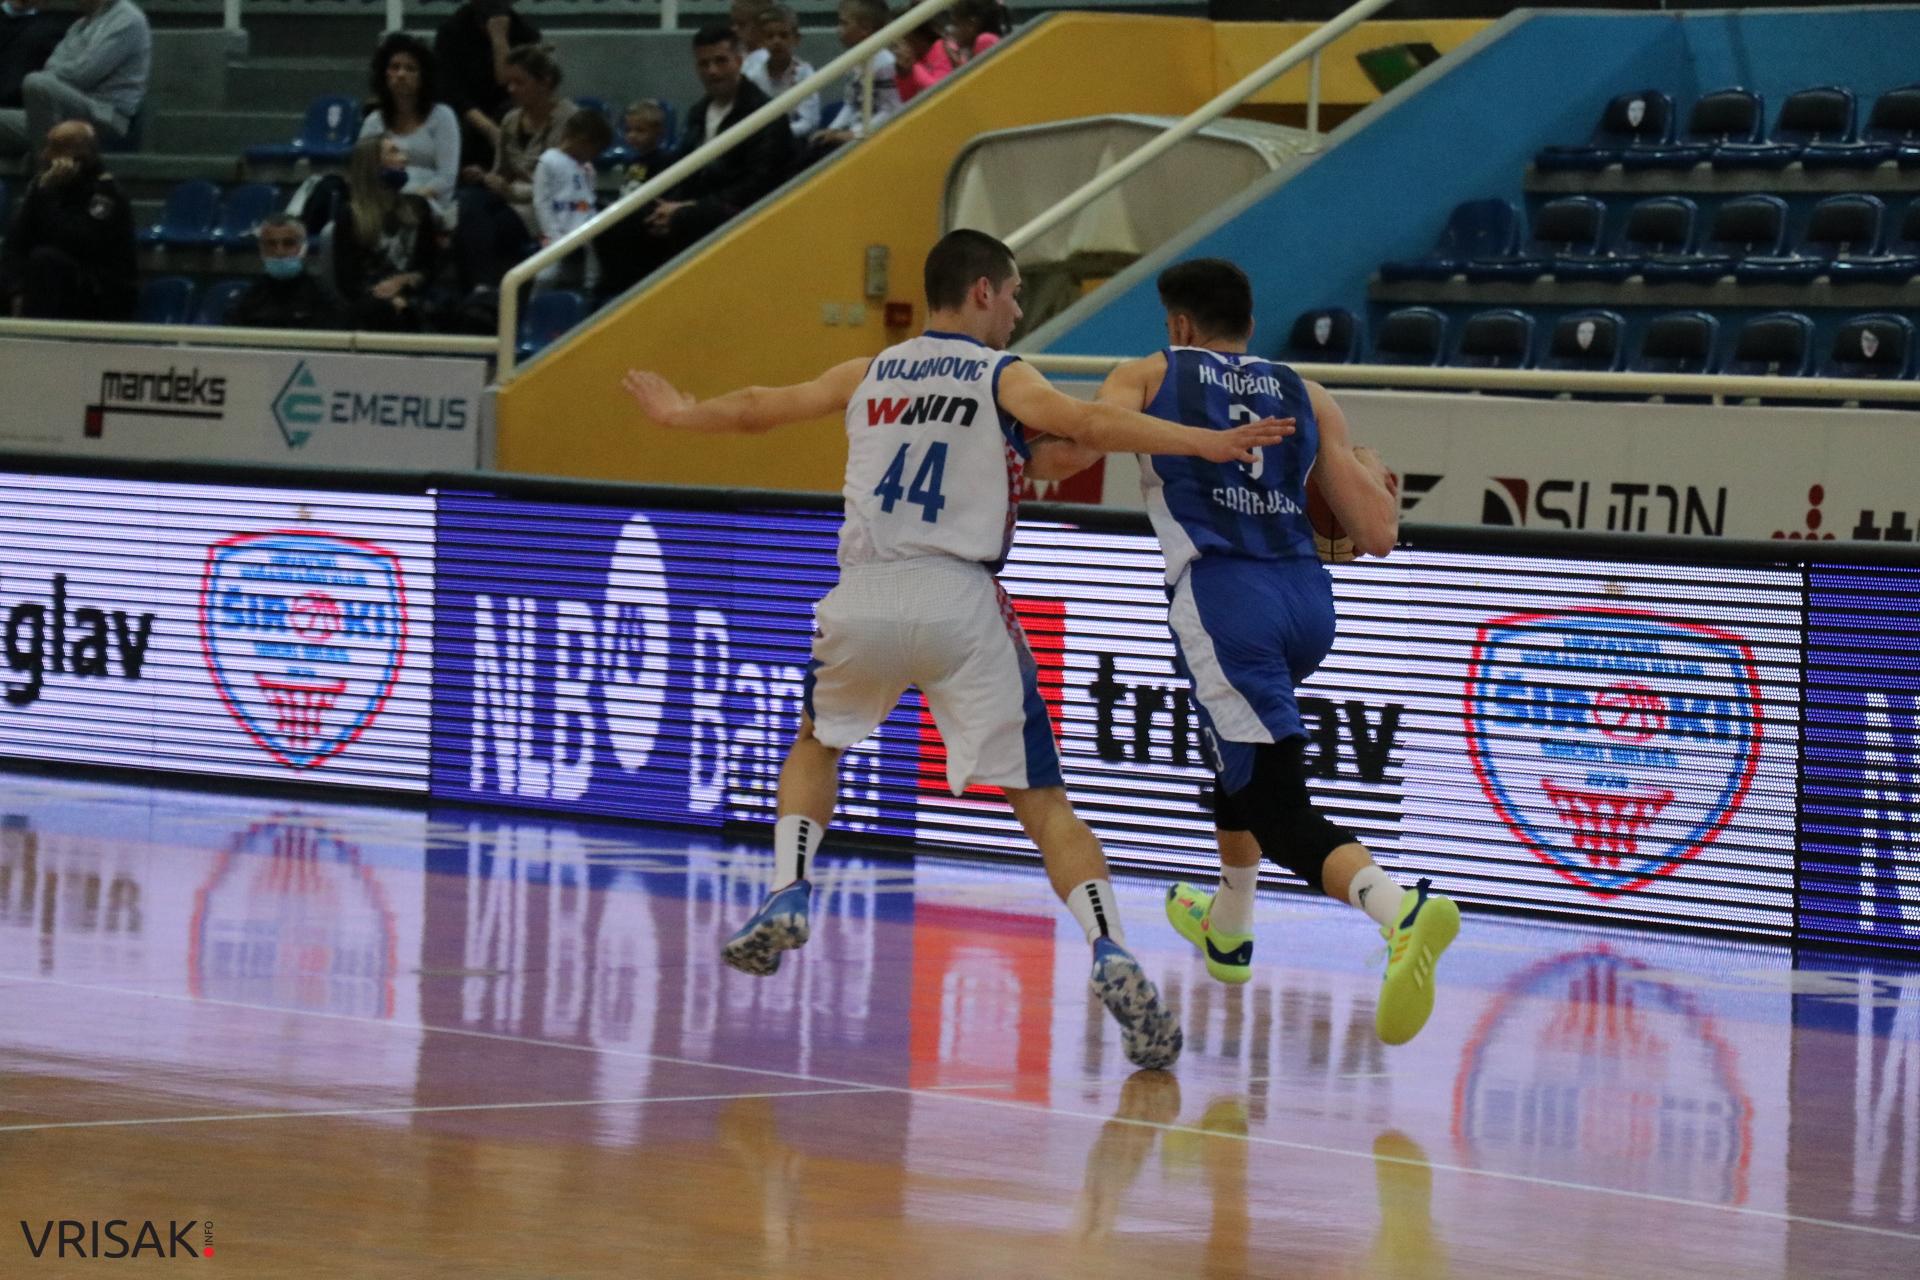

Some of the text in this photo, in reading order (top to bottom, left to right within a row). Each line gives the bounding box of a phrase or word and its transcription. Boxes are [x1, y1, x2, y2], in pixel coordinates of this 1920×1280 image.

[102, 366, 226, 405] mandeks
[876, 356, 988, 382] VUJANOVIĆ
[331, 392, 467, 431] EMERUS
[874, 441, 949, 523] 44
[469, 594, 597, 802] NLB
